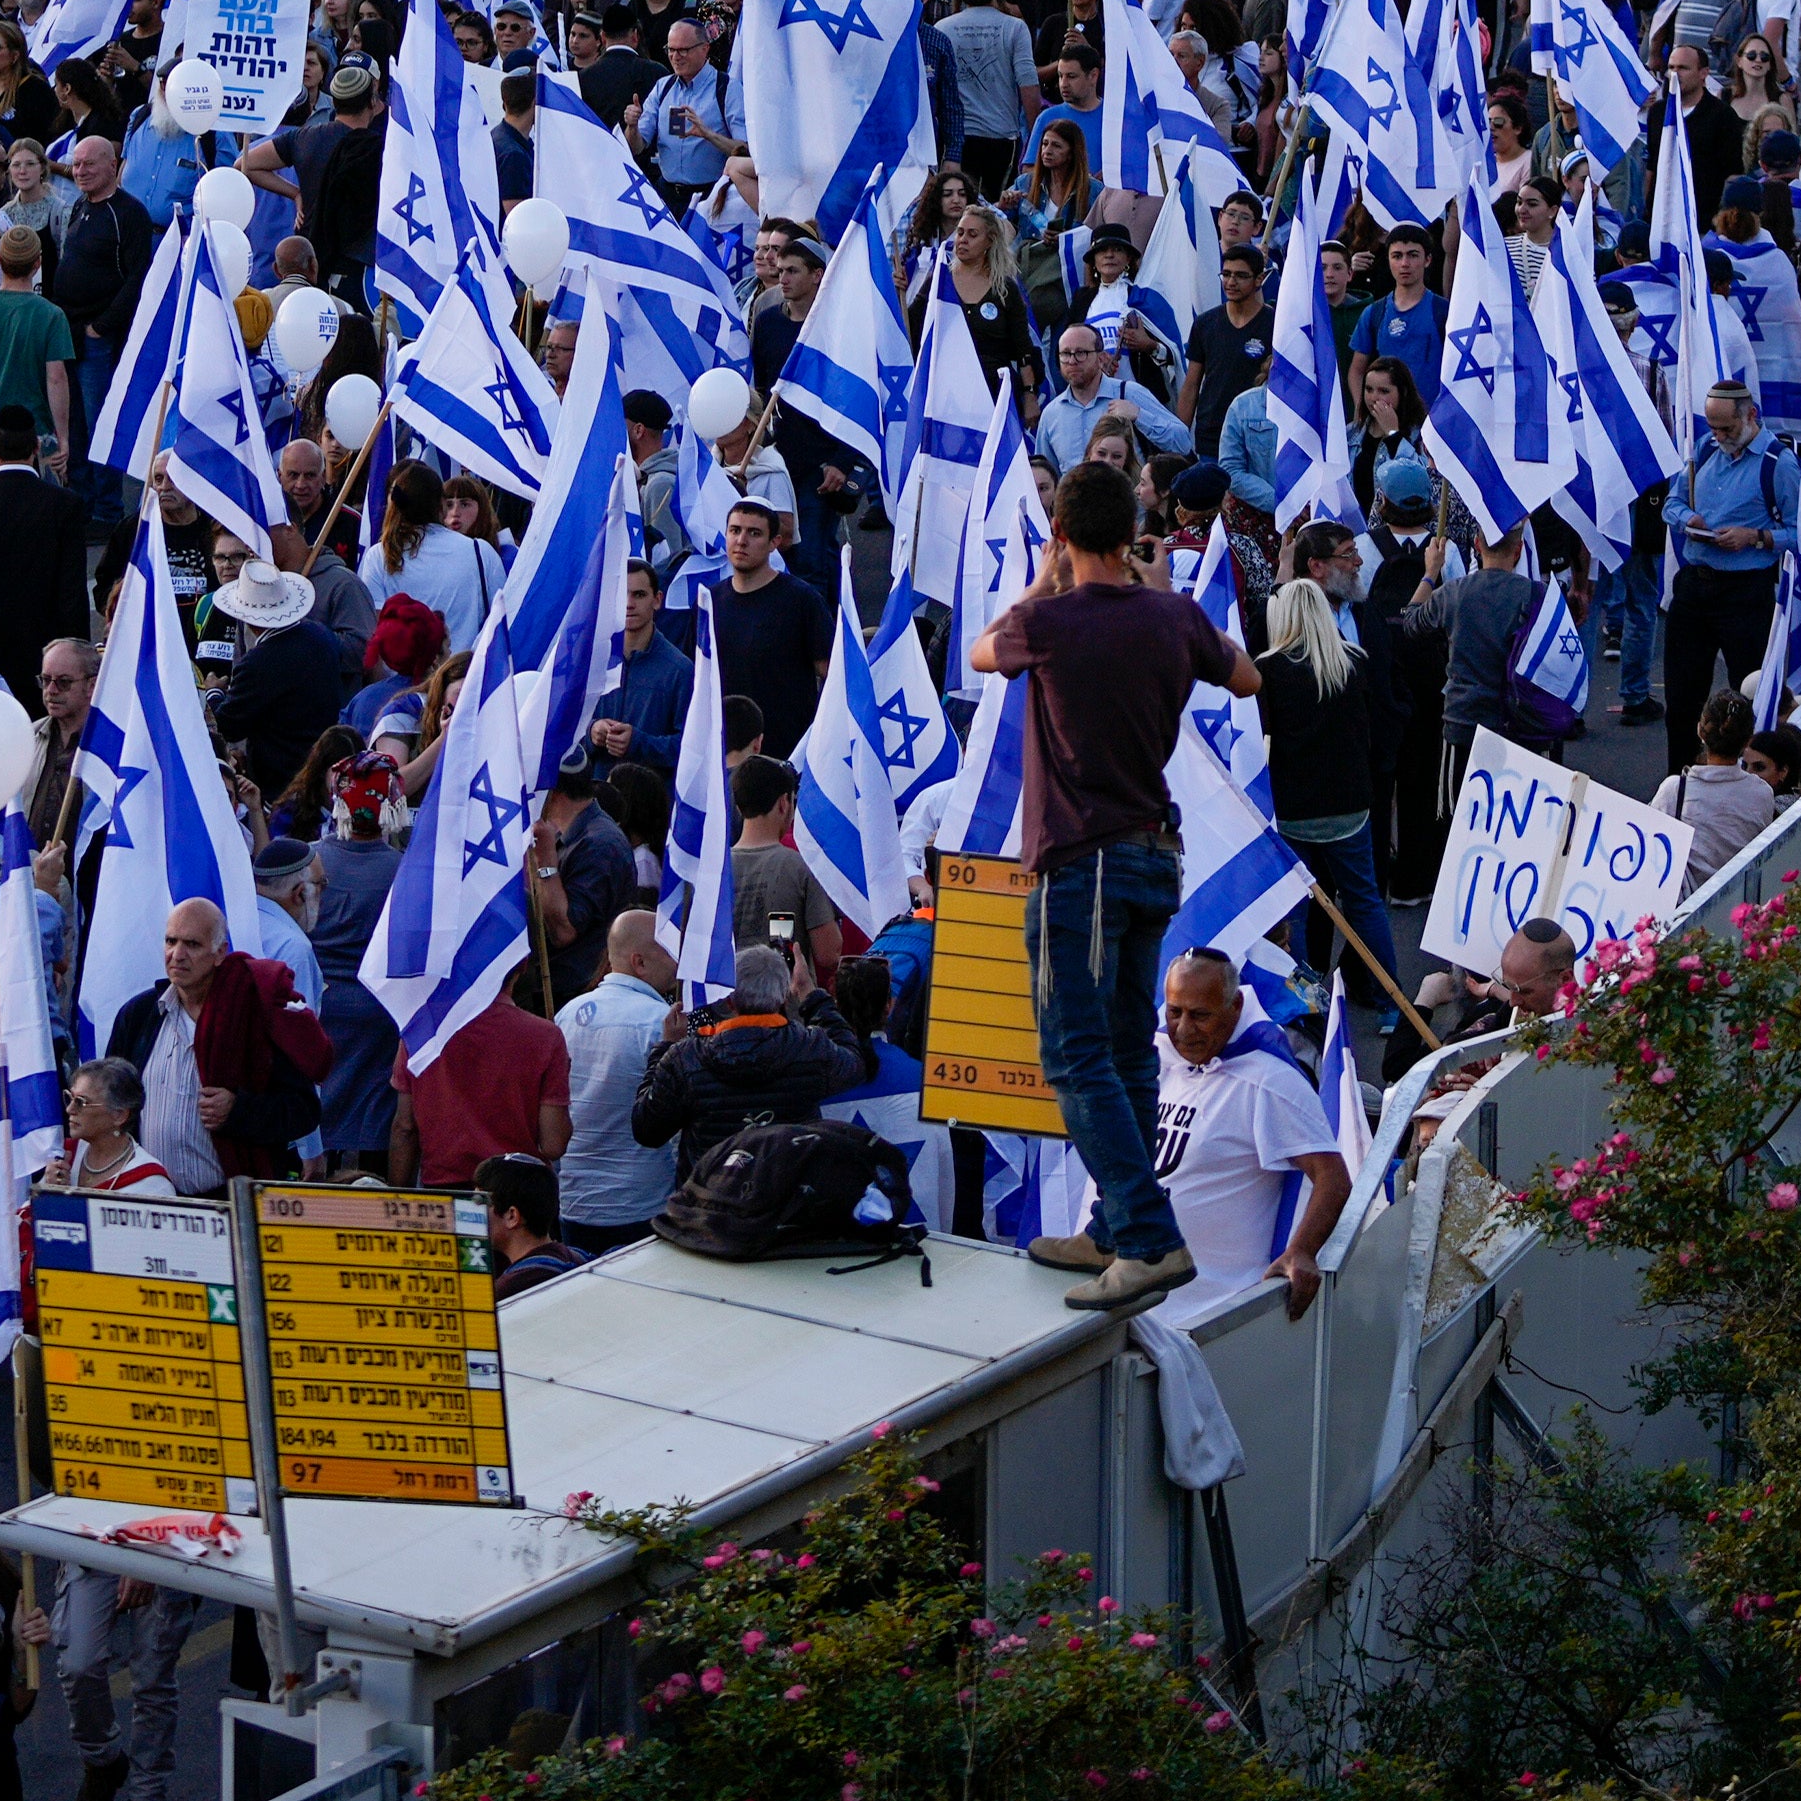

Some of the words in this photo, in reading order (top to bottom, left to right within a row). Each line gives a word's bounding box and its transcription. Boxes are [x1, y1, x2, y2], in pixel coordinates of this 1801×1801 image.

[217, 11, 275, 35] בחר
[209, 32, 277, 57] זהות
[947, 864, 976, 885] 90
[933, 1061, 978, 1084] 430
[998, 1070, 1036, 1088] בלבד
[269, 1199, 304, 1218] 100
[417, 1201, 446, 1219] בית
[211, 1218, 227, 1238] גן
[263, 1234, 284, 1253] 121
[335, 1232, 398, 1253] אדומים
[404, 1232, 453, 1257] מעלה
[40, 1278, 49, 1298] 7
[267, 1273, 292, 1292] 122
[338, 1270, 401, 1291] אדומים
[407, 1271, 455, 1296] מעלה
[138, 1284, 169, 1308] רחל
[174, 1290, 205, 1311] רמת
[270, 1312, 296, 1331] 156
[355, 1307, 388, 1328] ציון
[393, 1310, 459, 1331] מבשרת
[145, 1325, 208, 1351] שגרירות
[299, 1344, 341, 1365] רעות
[345, 1346, 398, 1368] מכבים
[403, 1350, 463, 1373] מודיעין
[117, 1362, 166, 1385] האומה
[170, 1368, 212, 1390] בנייני
[50, 1393, 68, 1412] 35
[302, 1383, 344, 1403] רעות
[348, 1385, 401, 1407] מכבים
[406, 1388, 466, 1411] מודיעין
[129, 1400, 177, 1423] הלאום
[180, 1408, 217, 1429] חניון
[103, 1436, 142, 1458] מזרח
[279, 1427, 337, 1449] 184,194
[361, 1430, 409, 1452] בלבד
[414, 1435, 470, 1456] הורדה
[146, 1442, 174, 1461] זאב
[178, 1445, 220, 1467] פסגת
[63, 1468, 101, 1491] 614
[290, 1462, 323, 1484] 97
[393, 1468, 428, 1488] רחל
[433, 1472, 469, 1491] רמת
[155, 1476, 188, 1492] שמש
[193, 1479, 218, 1495] בית
